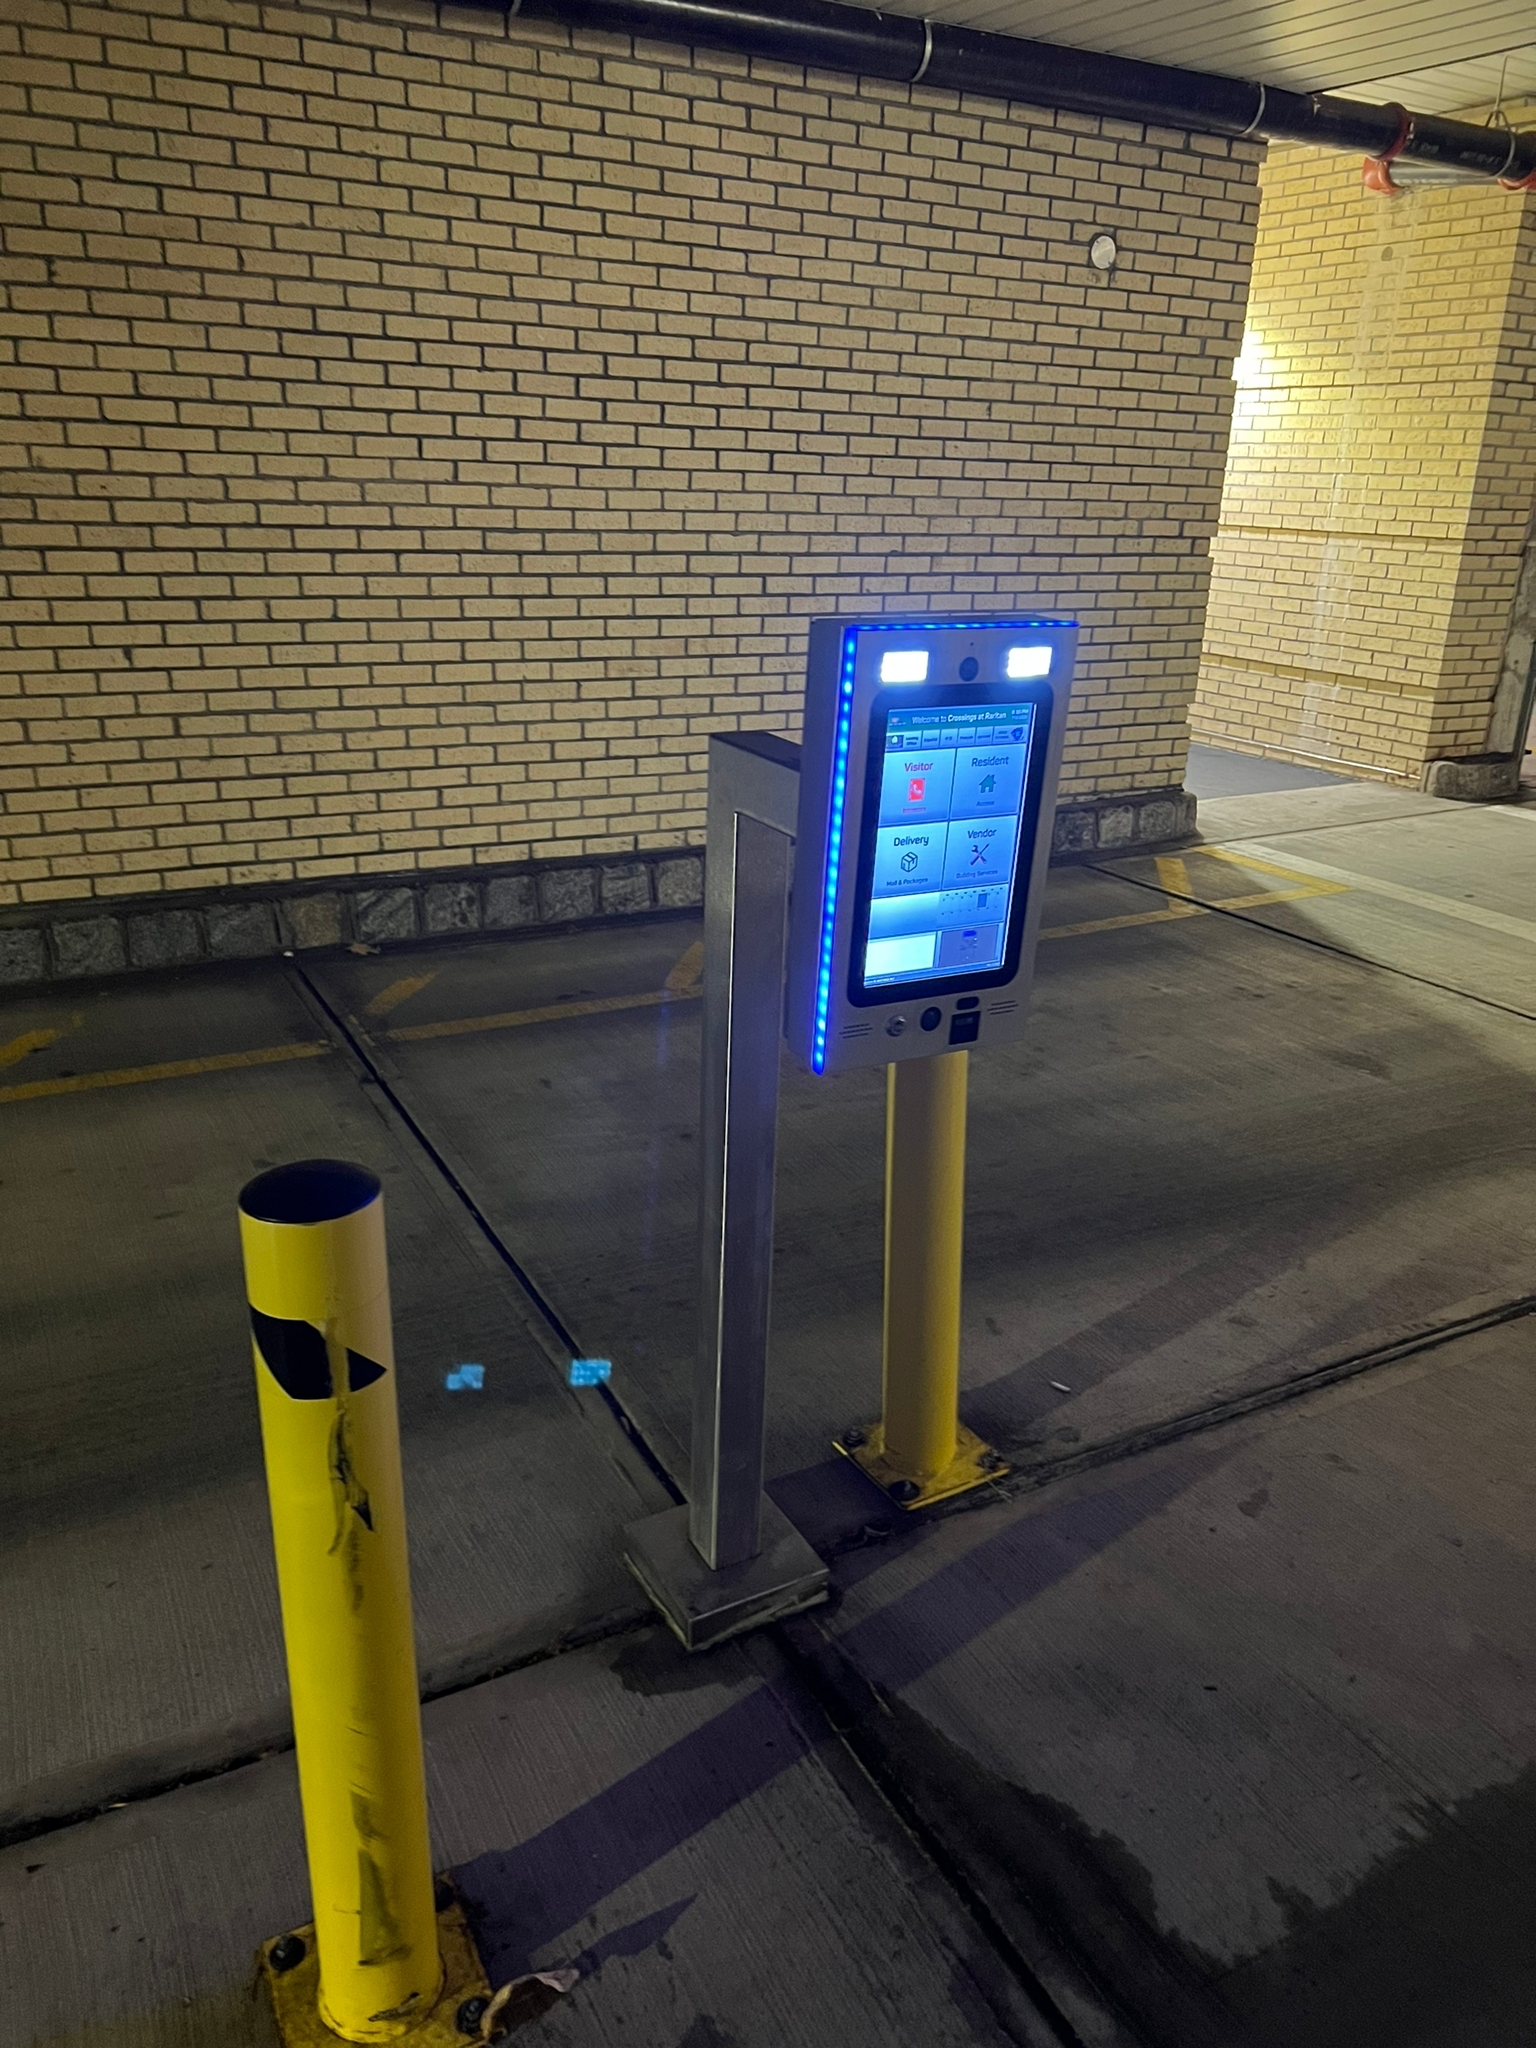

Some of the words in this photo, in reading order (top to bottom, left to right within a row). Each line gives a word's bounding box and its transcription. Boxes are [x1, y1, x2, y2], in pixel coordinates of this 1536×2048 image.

[912, 716, 939, 724] Welcome
[948, 713, 977, 723] Crossings
[985, 712, 1006, 720] Raritan
[904, 762, 933, 772] Visitor
[971, 756, 1009, 767] Resident
[967, 828, 997, 839] Vendor
[893, 836, 930, 847] Delivery
[977, 870, 998, 878] Services
[903, 877, 928, 886] Packages
